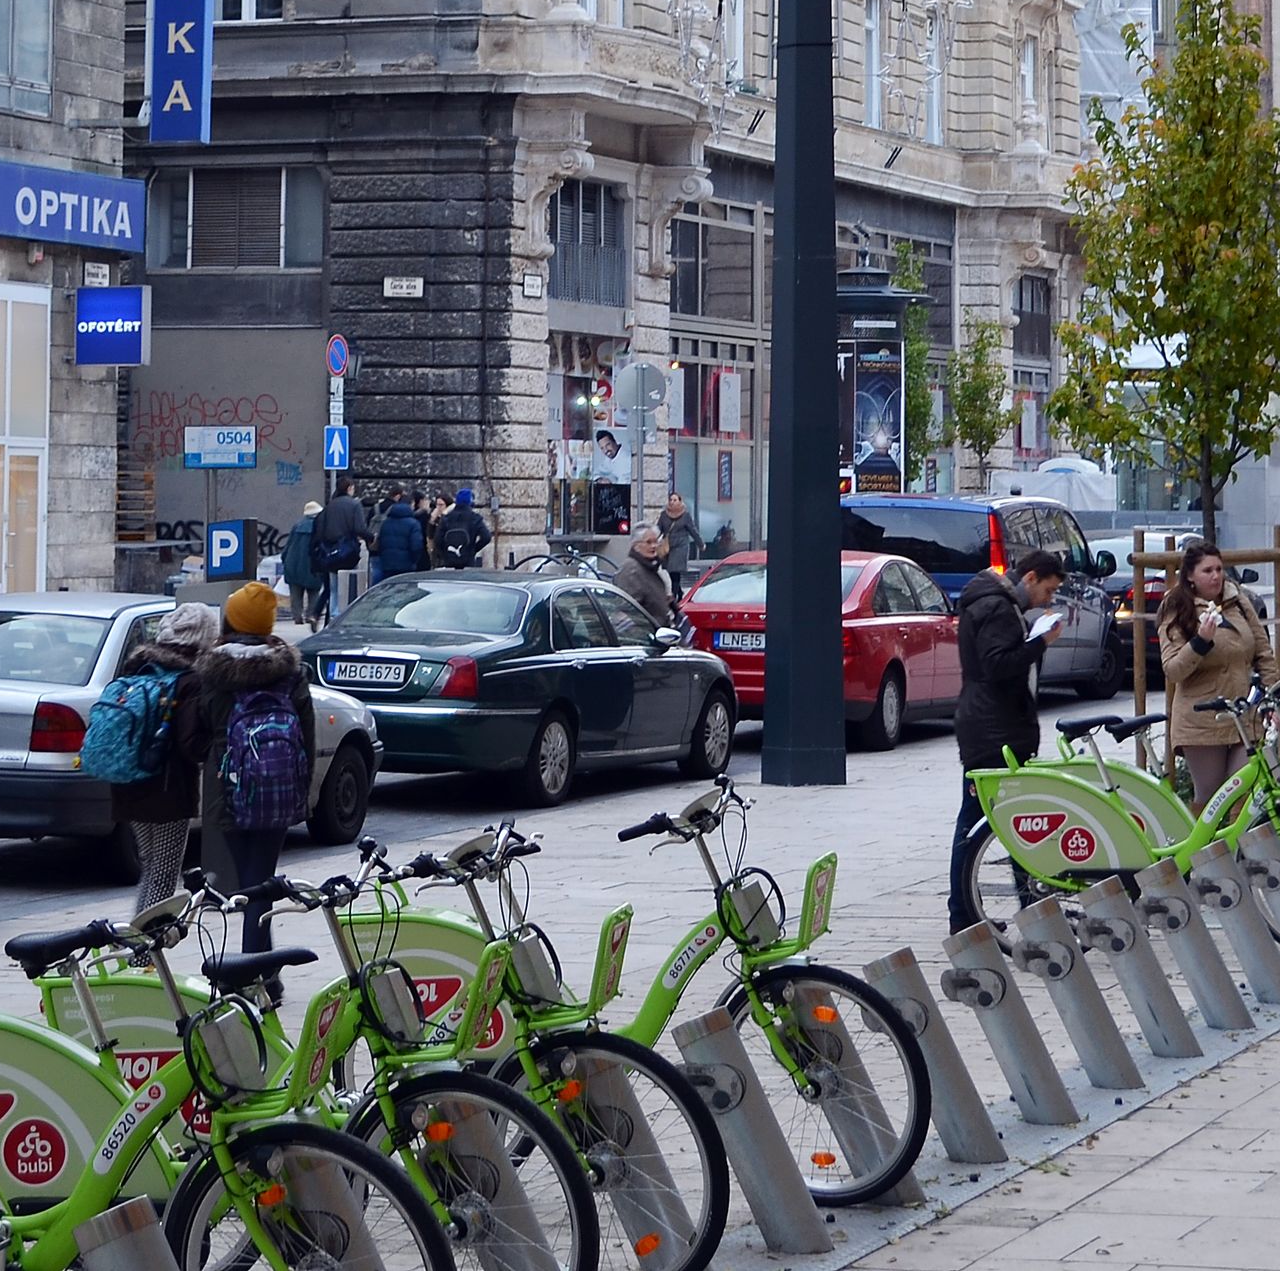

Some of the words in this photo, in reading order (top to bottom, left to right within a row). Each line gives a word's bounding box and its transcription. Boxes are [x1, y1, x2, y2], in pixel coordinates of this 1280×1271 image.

[14, 186, 133, 239] OPTIKA
[77, 318, 142, 333] OFOTÉRT
[216, 431, 252, 445] 0504
[212, 530, 239, 568] P
[1018, 816, 1049, 833] MOL
[1068, 847, 1089, 858] bubi
[669, 945, 697, 979] 86771
[101, 1111, 137, 1160] 86520
[17, 1158, 53, 1174] bubi
